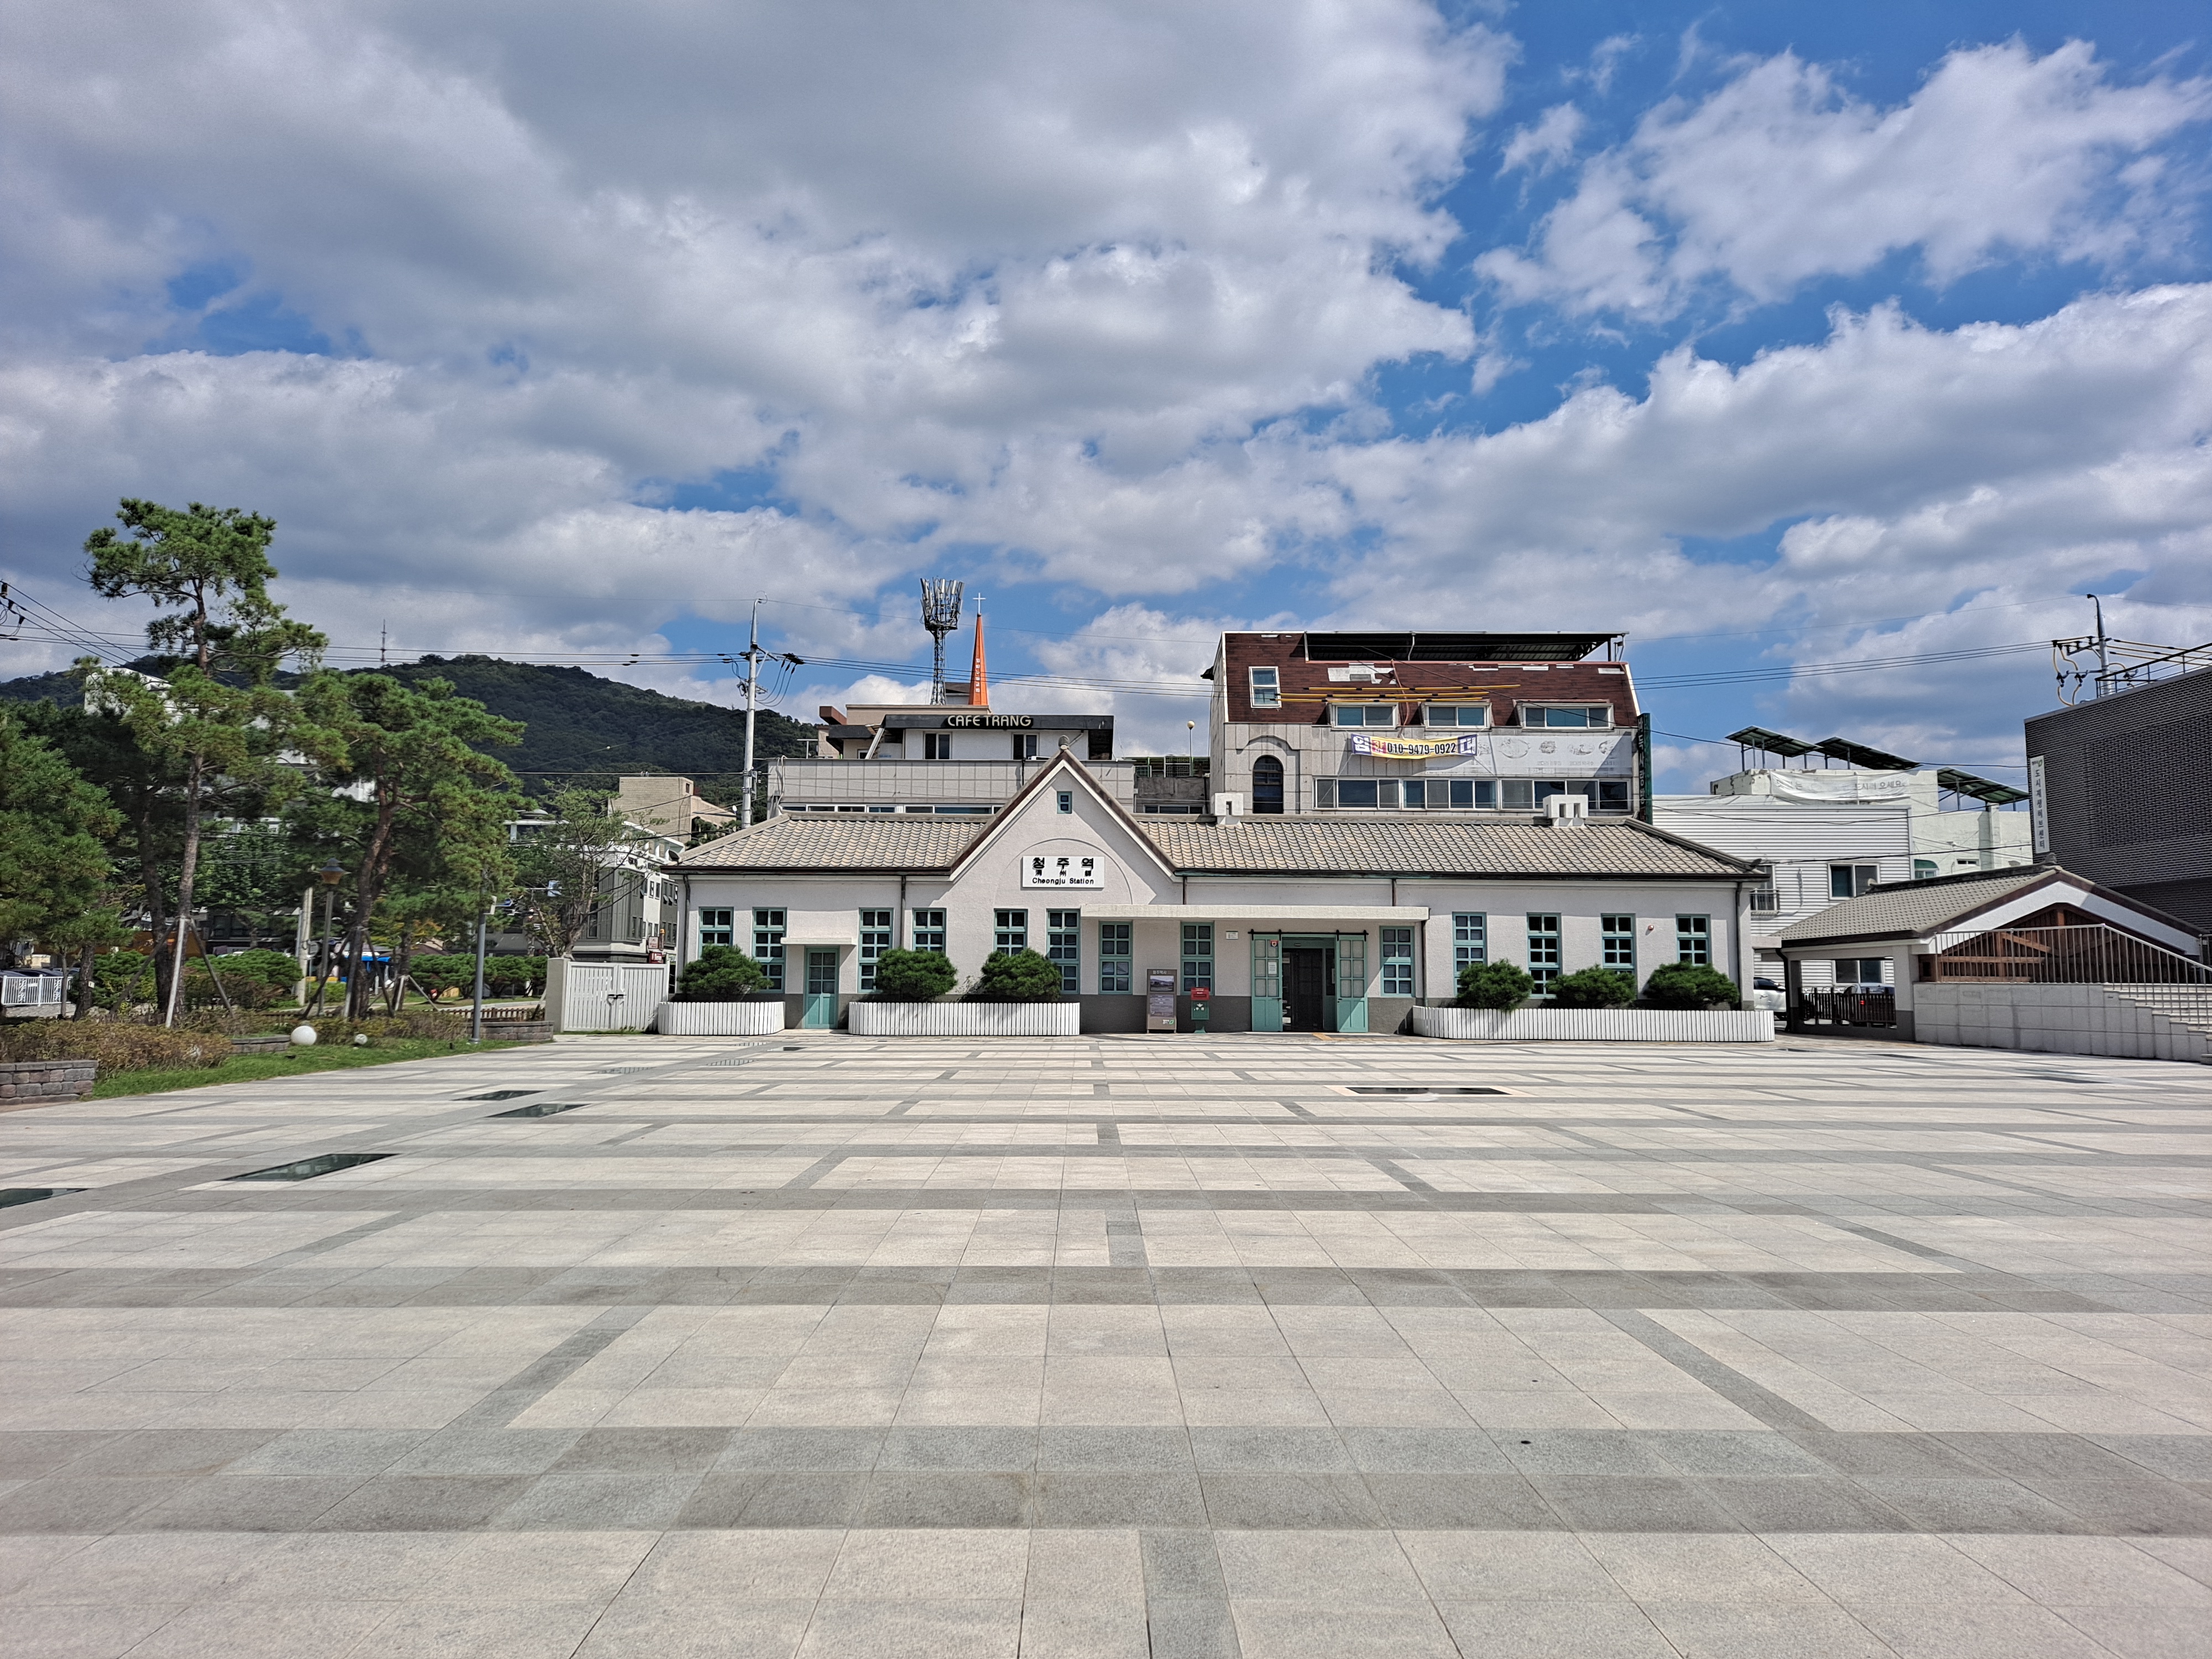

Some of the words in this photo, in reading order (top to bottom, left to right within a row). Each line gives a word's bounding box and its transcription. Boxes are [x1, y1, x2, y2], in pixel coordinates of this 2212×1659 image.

[947, 715, 980, 727] CAFE
[983, 715, 1031, 727] TRANG
[1353, 735, 1371, 753] 임
[1387, 742, 1457, 755] 010-9479-0922
[1460, 737, 1477, 754] 대
[1032, 857, 1094, 869] 청주역
